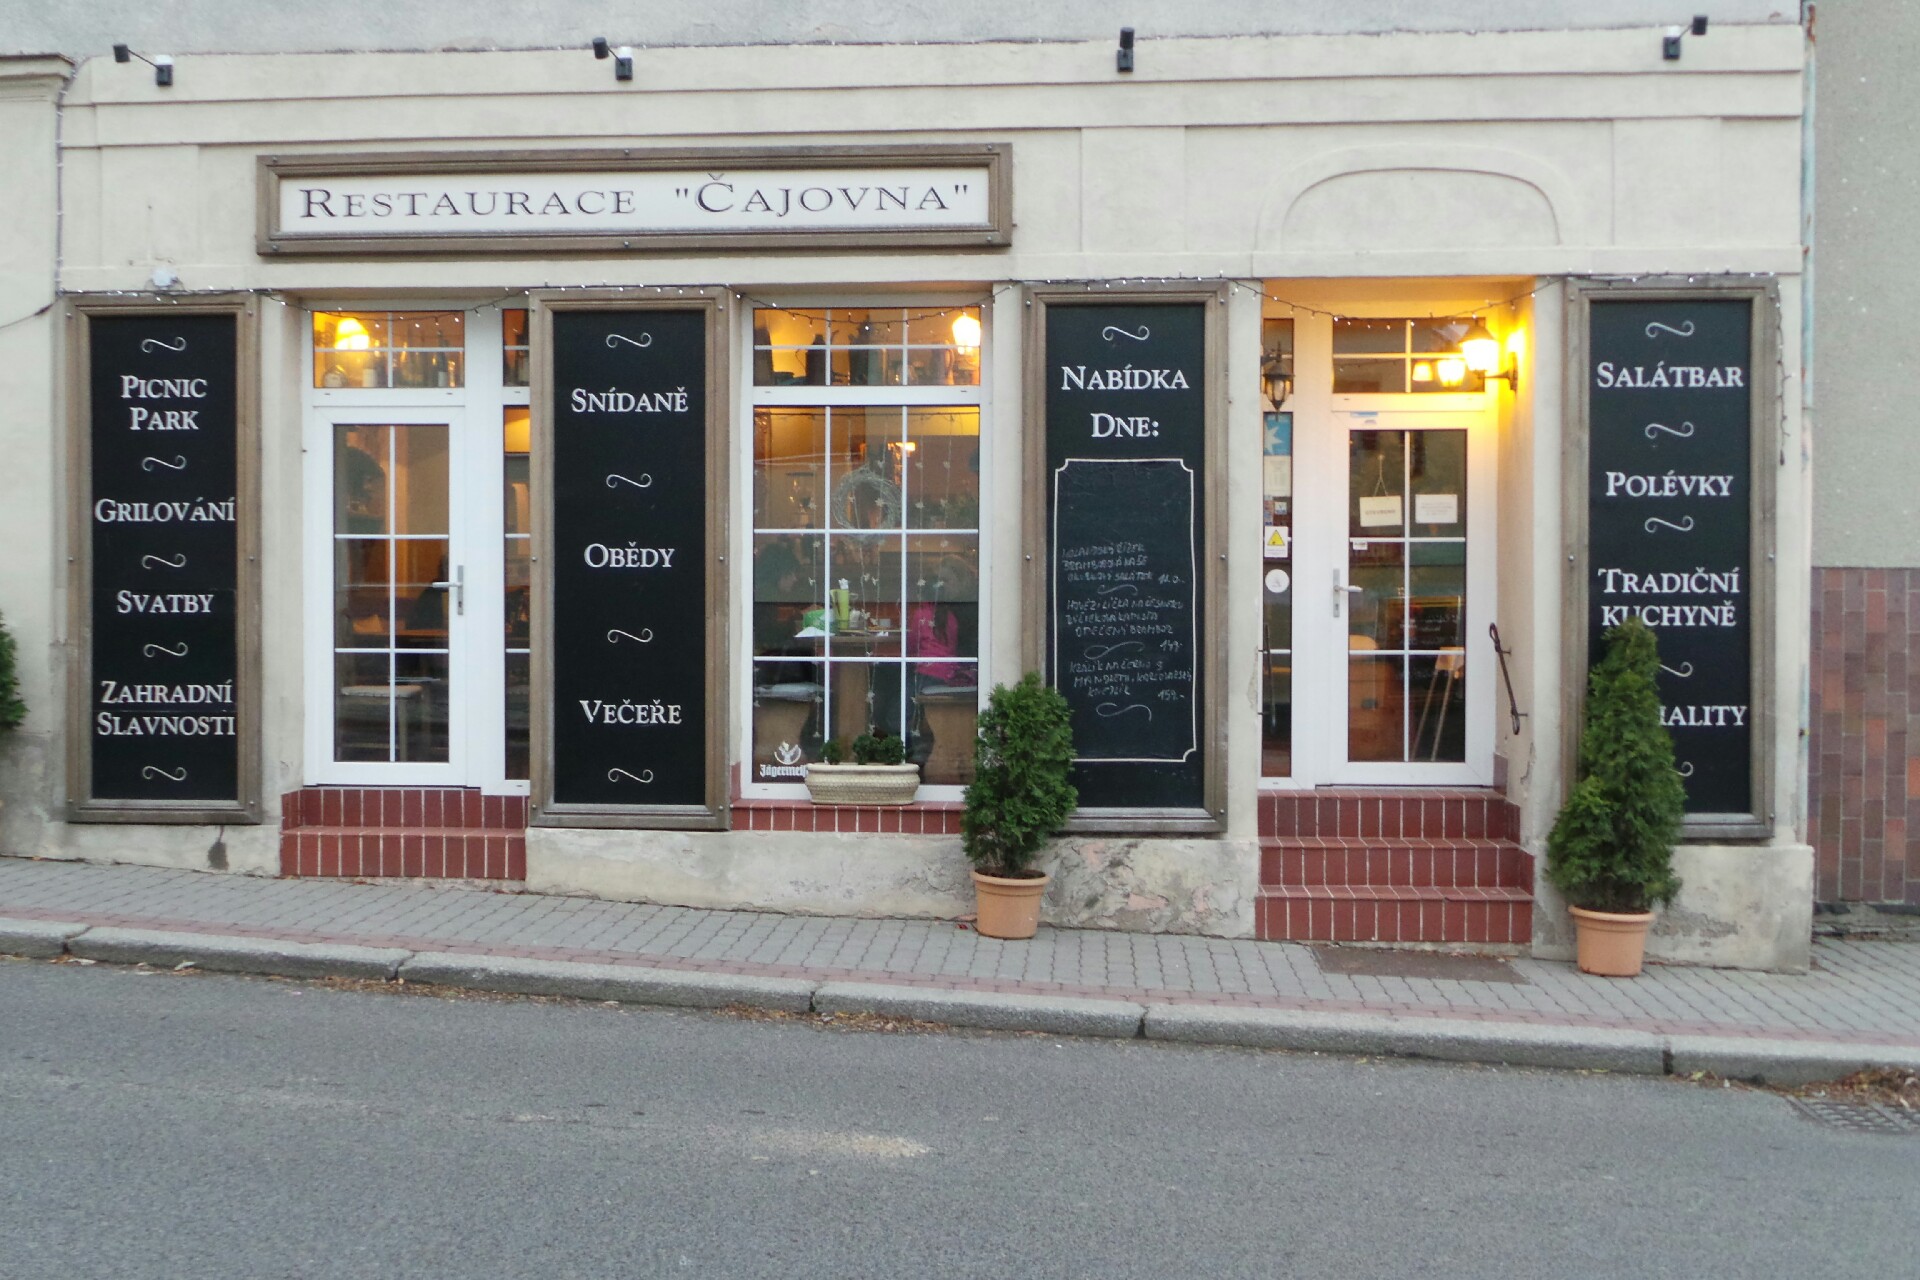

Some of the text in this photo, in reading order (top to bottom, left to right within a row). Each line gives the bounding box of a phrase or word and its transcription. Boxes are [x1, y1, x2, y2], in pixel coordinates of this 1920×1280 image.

[301, 173, 969, 219] RESTAURACE "ČAJOVNA"
[120, 374, 208, 399] PICNIC
[1061, 363, 1190, 391] NABÍDKA
[1596, 360, 1744, 388] SALÁTBAR
[571, 386, 689, 413] SNÍDANĚ
[129, 406, 199, 432] PARK
[1090, 412, 1160, 438] DNE:
[1605, 469, 1734, 497] POLÉVKY
[94, 496, 236, 523] GRILOVÁNÍ
[583, 541, 675, 568] OBĚDY
[1597, 566, 1741, 594] TRADIČNÍ
[117, 589, 214, 614] SVATBY
[101, 679, 233, 704] ZAHRADNÍ
[97, 711, 235, 736] SLAVNOSTI
[579, 698, 682, 725] VEČEŘE
[1659, 705, 1748, 726] IALITY
